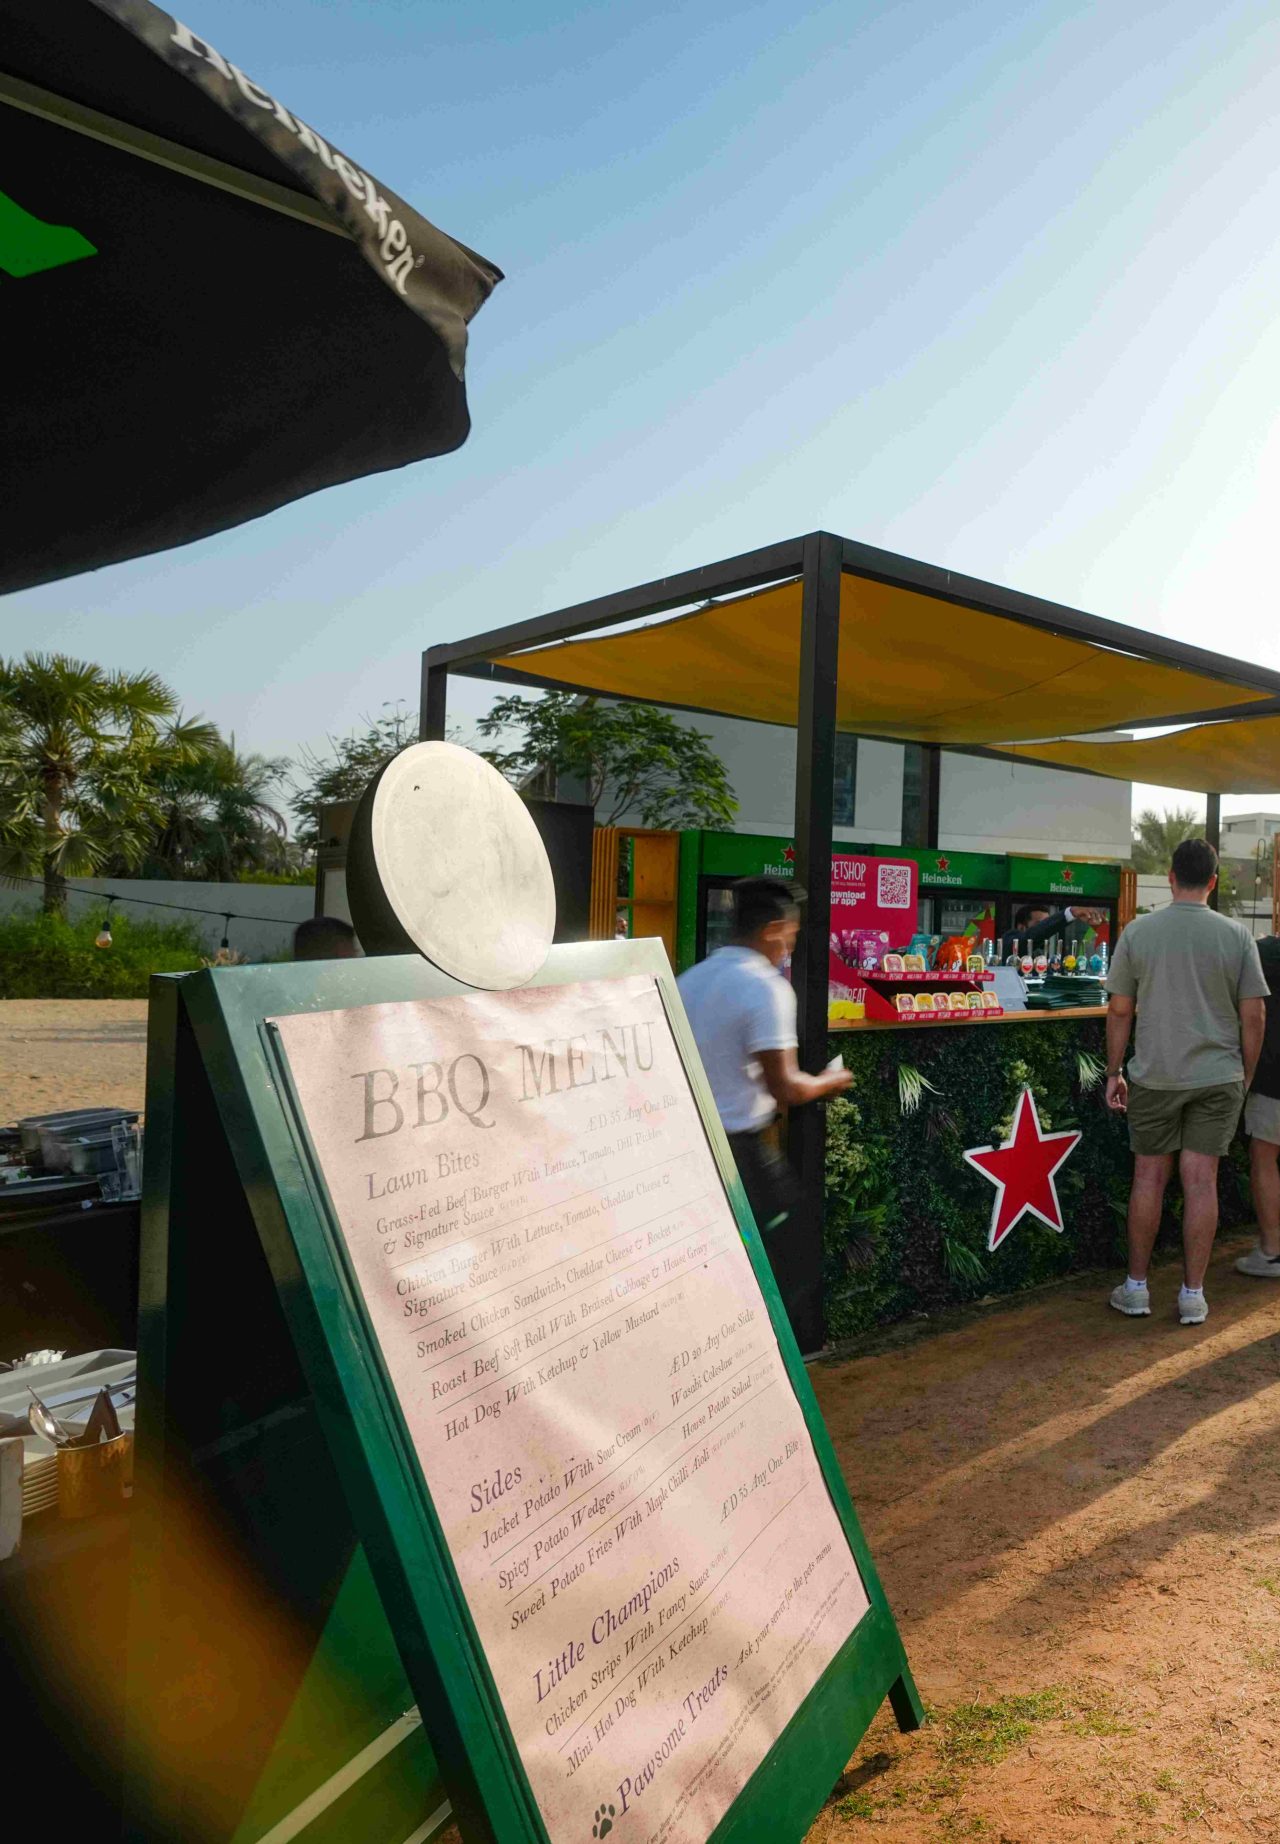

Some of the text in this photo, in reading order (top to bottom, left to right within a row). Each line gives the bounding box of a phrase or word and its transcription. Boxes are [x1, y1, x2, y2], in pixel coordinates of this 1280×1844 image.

[763, 863, 794, 877] Heine
[830, 890, 866, 899] ownload
[922, 872, 962, 885] Heineken
[1050, 881, 1084, 895] Heineken
[350, 1021, 655, 1143] BBQ MENU
[624, 1105, 642, 1122] Any
[643, 1099, 660, 1114] One
[364, 1151, 480, 1201] Lawn Bites
[376, 1199, 441, 1235] Grass-Fed
[446, 1188, 467, 1213] Beef
[472, 1181, 509, 1202] Burger
[512, 1167, 540, 1187] With
[544, 1158, 580, 1177] Lettuce,
[579, 1145, 615, 1164] Tomato,
[617, 1135, 633, 1151] Dill
[383, 1206, 494, 1255] & Signature Sauce
[396, 1266, 446, 1296] Chicken
[450, 1247, 488, 1273] Burger
[491, 1235, 521, 1257] With
[524, 1222, 563, 1243] Lettuce,
[562, 1206, 600, 1227] Tomato,
[600, 1188, 634, 1210] Cheddar
[636, 1180, 660, 1196] Cheese
[403, 1270, 498, 1317] Signature Sauce
[416, 1321, 467, 1358] Smoked
[470, 1306, 510, 1332] Chicken
[513, 1277, 566, 1311] Sandwich,
[566, 1258, 603, 1284] Cheddar
[605, 1244, 633, 1264] Cheese
[647, 1224, 671, 1245] Rocket
[431, 1369, 467, 1400] Roast
[473, 1348, 500, 1378] Beef
[503, 1339, 521, 1361] Soft
[524, 1324, 546, 1348] Roll
[549, 1310, 577, 1335] With
[580, 1293, 614, 1320] Braised
[615, 1273, 650, 1298] Cabbage
[663, 1254, 686, 1273] House
[686, 1243, 708, 1260] Gravy
[703, 1333, 720, 1354] Any
[721, 1323, 737, 1339] One
[737, 1308, 755, 1327] Side
[444, 1302, 659, 1442] Hot Dog With Ketchup & Yellow Mustard
[671, 1377, 702, 1408] Wasabi
[702, 1357, 733, 1383] Coleslaw
[682, 1415, 706, 1440] House
[707, 1396, 730, 1420] Potato
[731, 1375, 752, 1399] Salad
[470, 1465, 522, 1513] Sides
[482, 1511, 520, 1550] Jacket
[523, 1485, 560, 1519] Potato
[562, 1459, 594, 1490] With
[597, 1445, 615, 1465] Sour
[615, 1426, 642, 1448] Cream
[750, 1469, 767, 1493] Any
[767, 1455, 784, 1474] One
[784, 1440, 800, 1460] Bite
[498, 1489, 615, 1591] Spicy Potato Wedges
[510, 1591, 547, 1631] Sweet
[550, 1561, 585, 1599] Potato
[586, 1537, 613, 1567] Fries
[615, 1510, 643, 1543] With
[645, 1487, 669, 1518] Maple
[668, 1465, 689, 1493] Chilli
[691, 1447, 710, 1475] Aioli
[533, 1555, 680, 1704] Little Champions
[545, 1688, 588, 1737] Chicken
[591, 1653, 621, 1690] Strips
[624, 1620, 655, 1657] With
[658, 1593, 687, 1629] Fancy
[689, 1567, 710, 1596] Sauce
[566, 1616, 709, 1779] Mini Hot Dog With Ketchup
[616, 1718, 686, 1816] Pawsome
[682, 1663, 728, 1723] Treats
[735, 1641, 753, 1671] Ask
[755, 1623, 770, 1654] your
[770, 1600, 785, 1627] server
[793, 1577, 803, 1592] the
[803, 1561, 815, 1585] pets
[815, 1543, 832, 1564] menu
